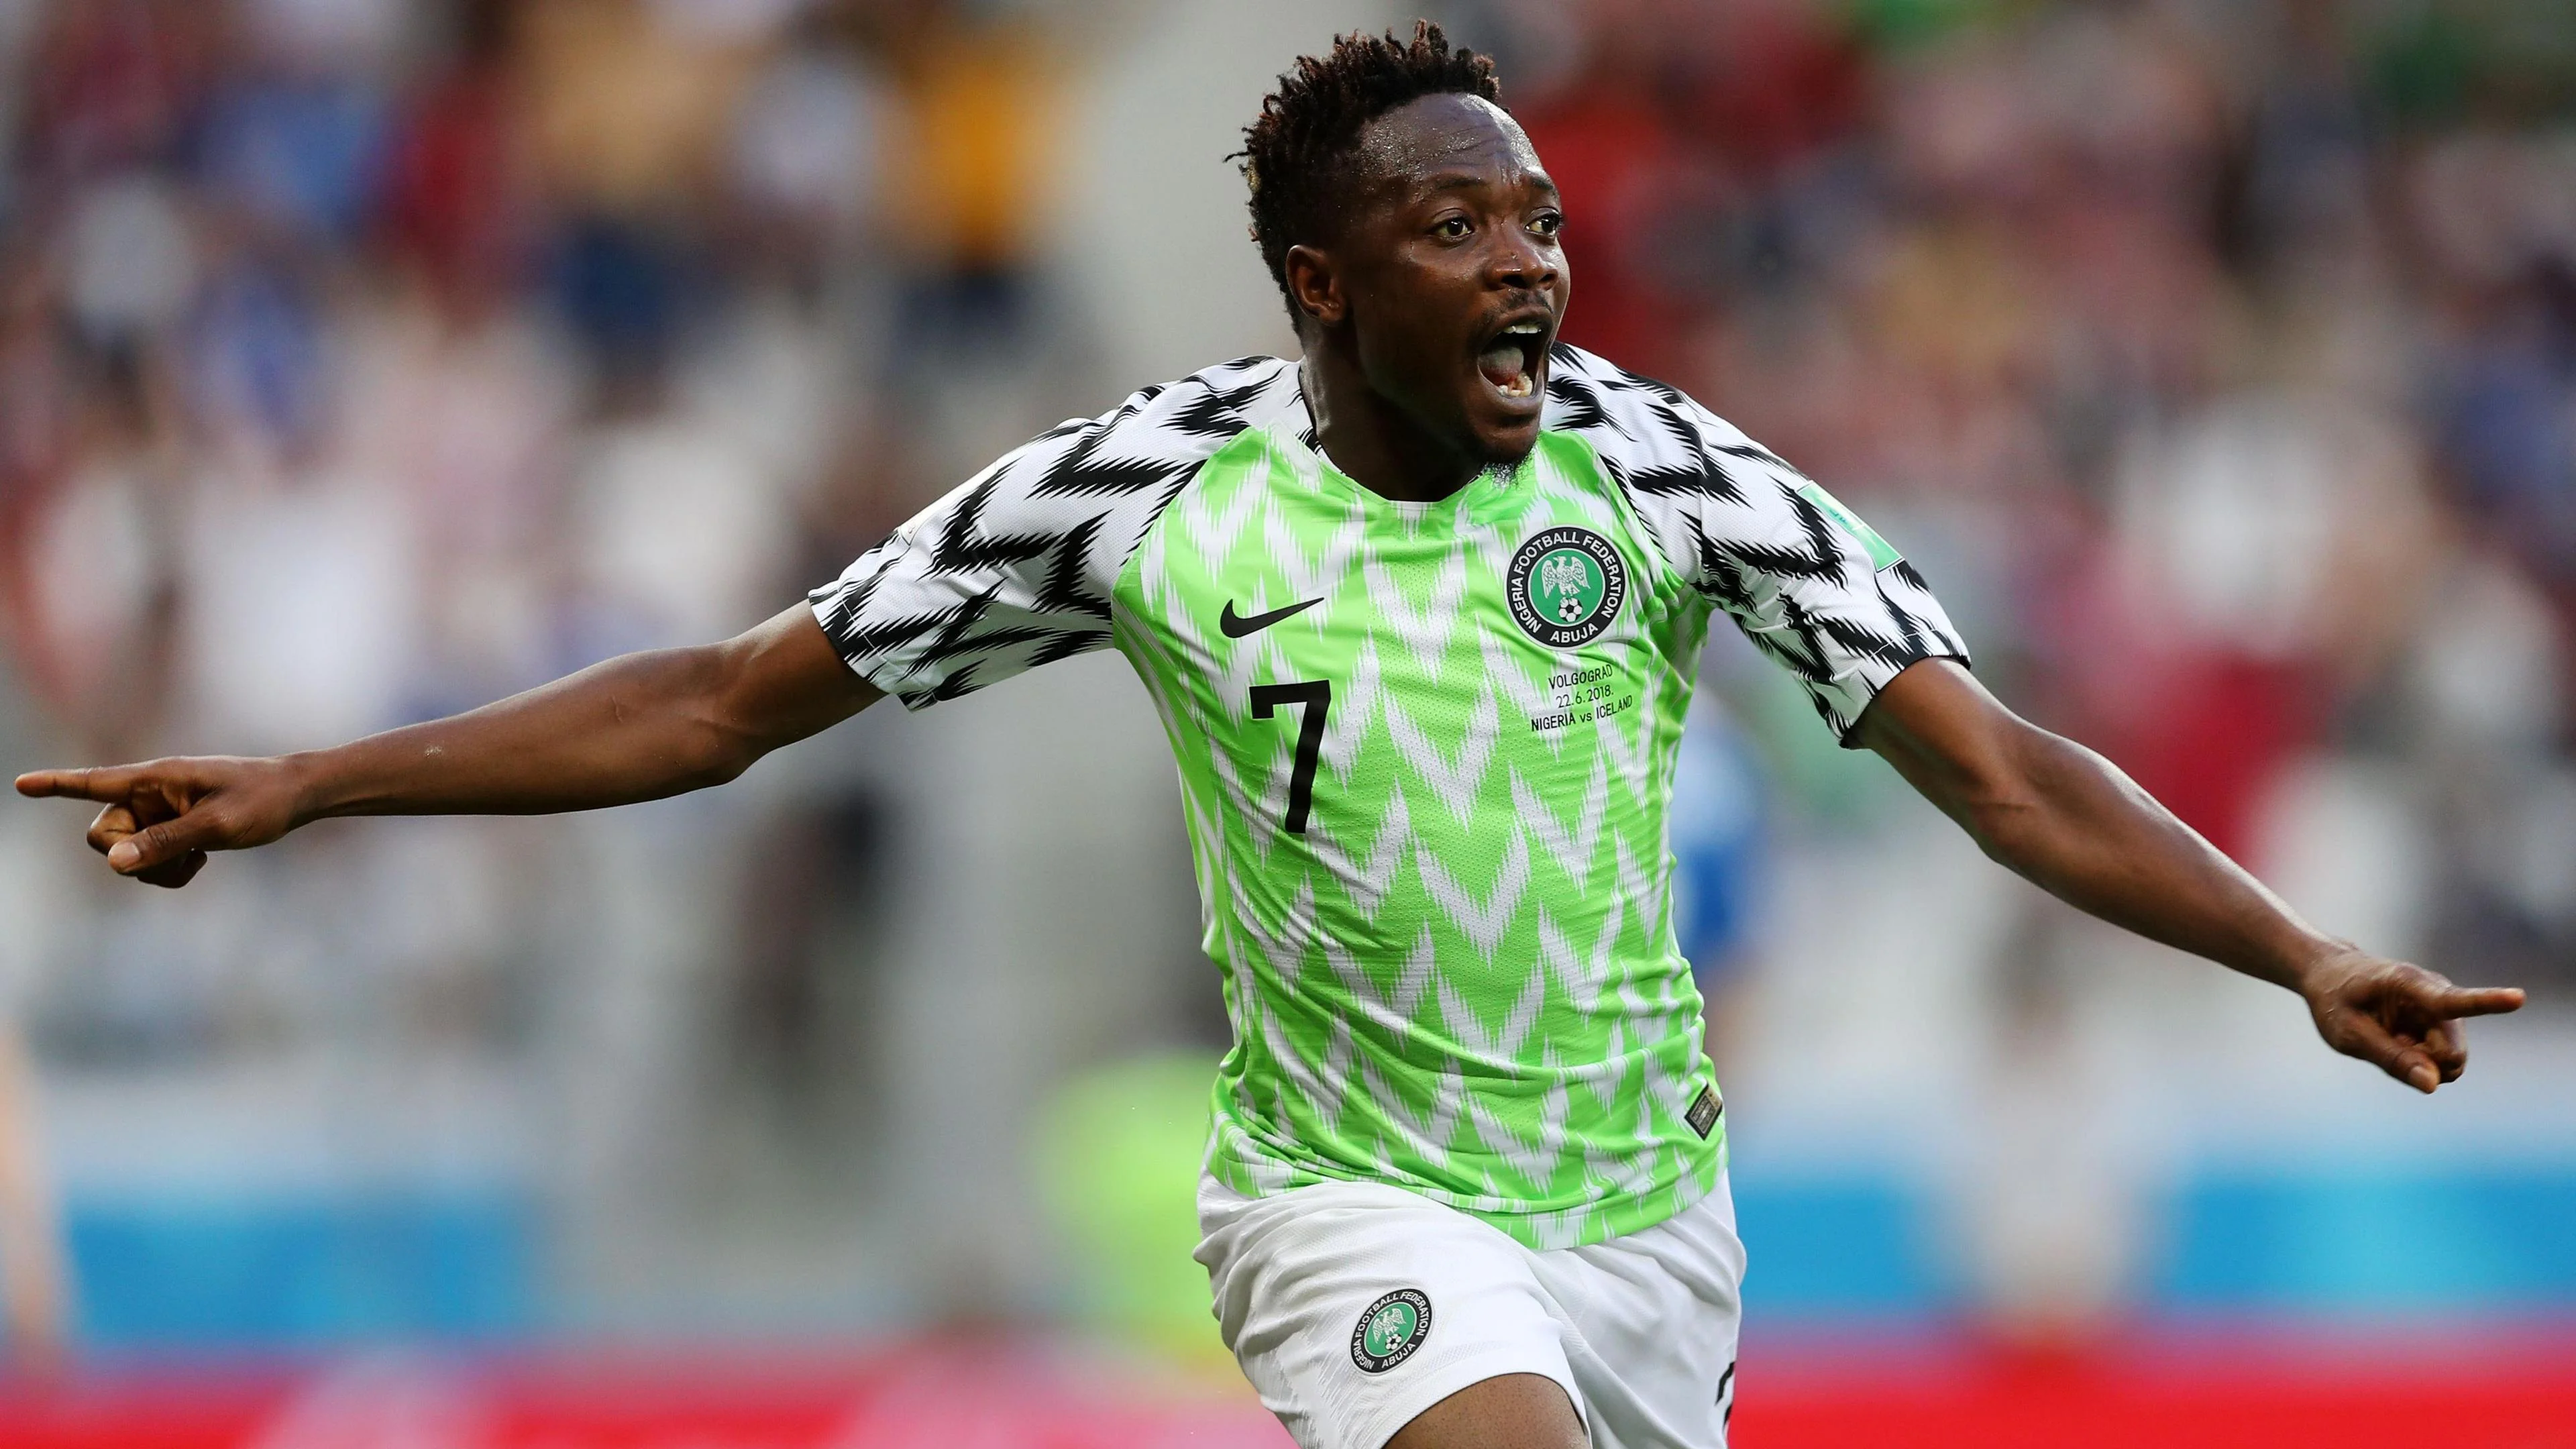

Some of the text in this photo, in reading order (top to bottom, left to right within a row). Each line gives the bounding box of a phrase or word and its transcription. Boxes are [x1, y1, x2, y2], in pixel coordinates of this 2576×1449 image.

[1511, 531, 1622, 633] NIGERIA FOOTBALL FEDERATION
[1550, 623, 1599, 643] ABUJA
[1548, 664, 1613, 690] VOLGOGRAD
[1531, 695, 1633, 732] NIGERIA vs ICELAND
[1249, 680, 1332, 835] 7
[1353, 1291, 1430, 1370] NIGERIA FOOTBALL FEDERATION
[1381, 1342, 1417, 1369] ABUJA
